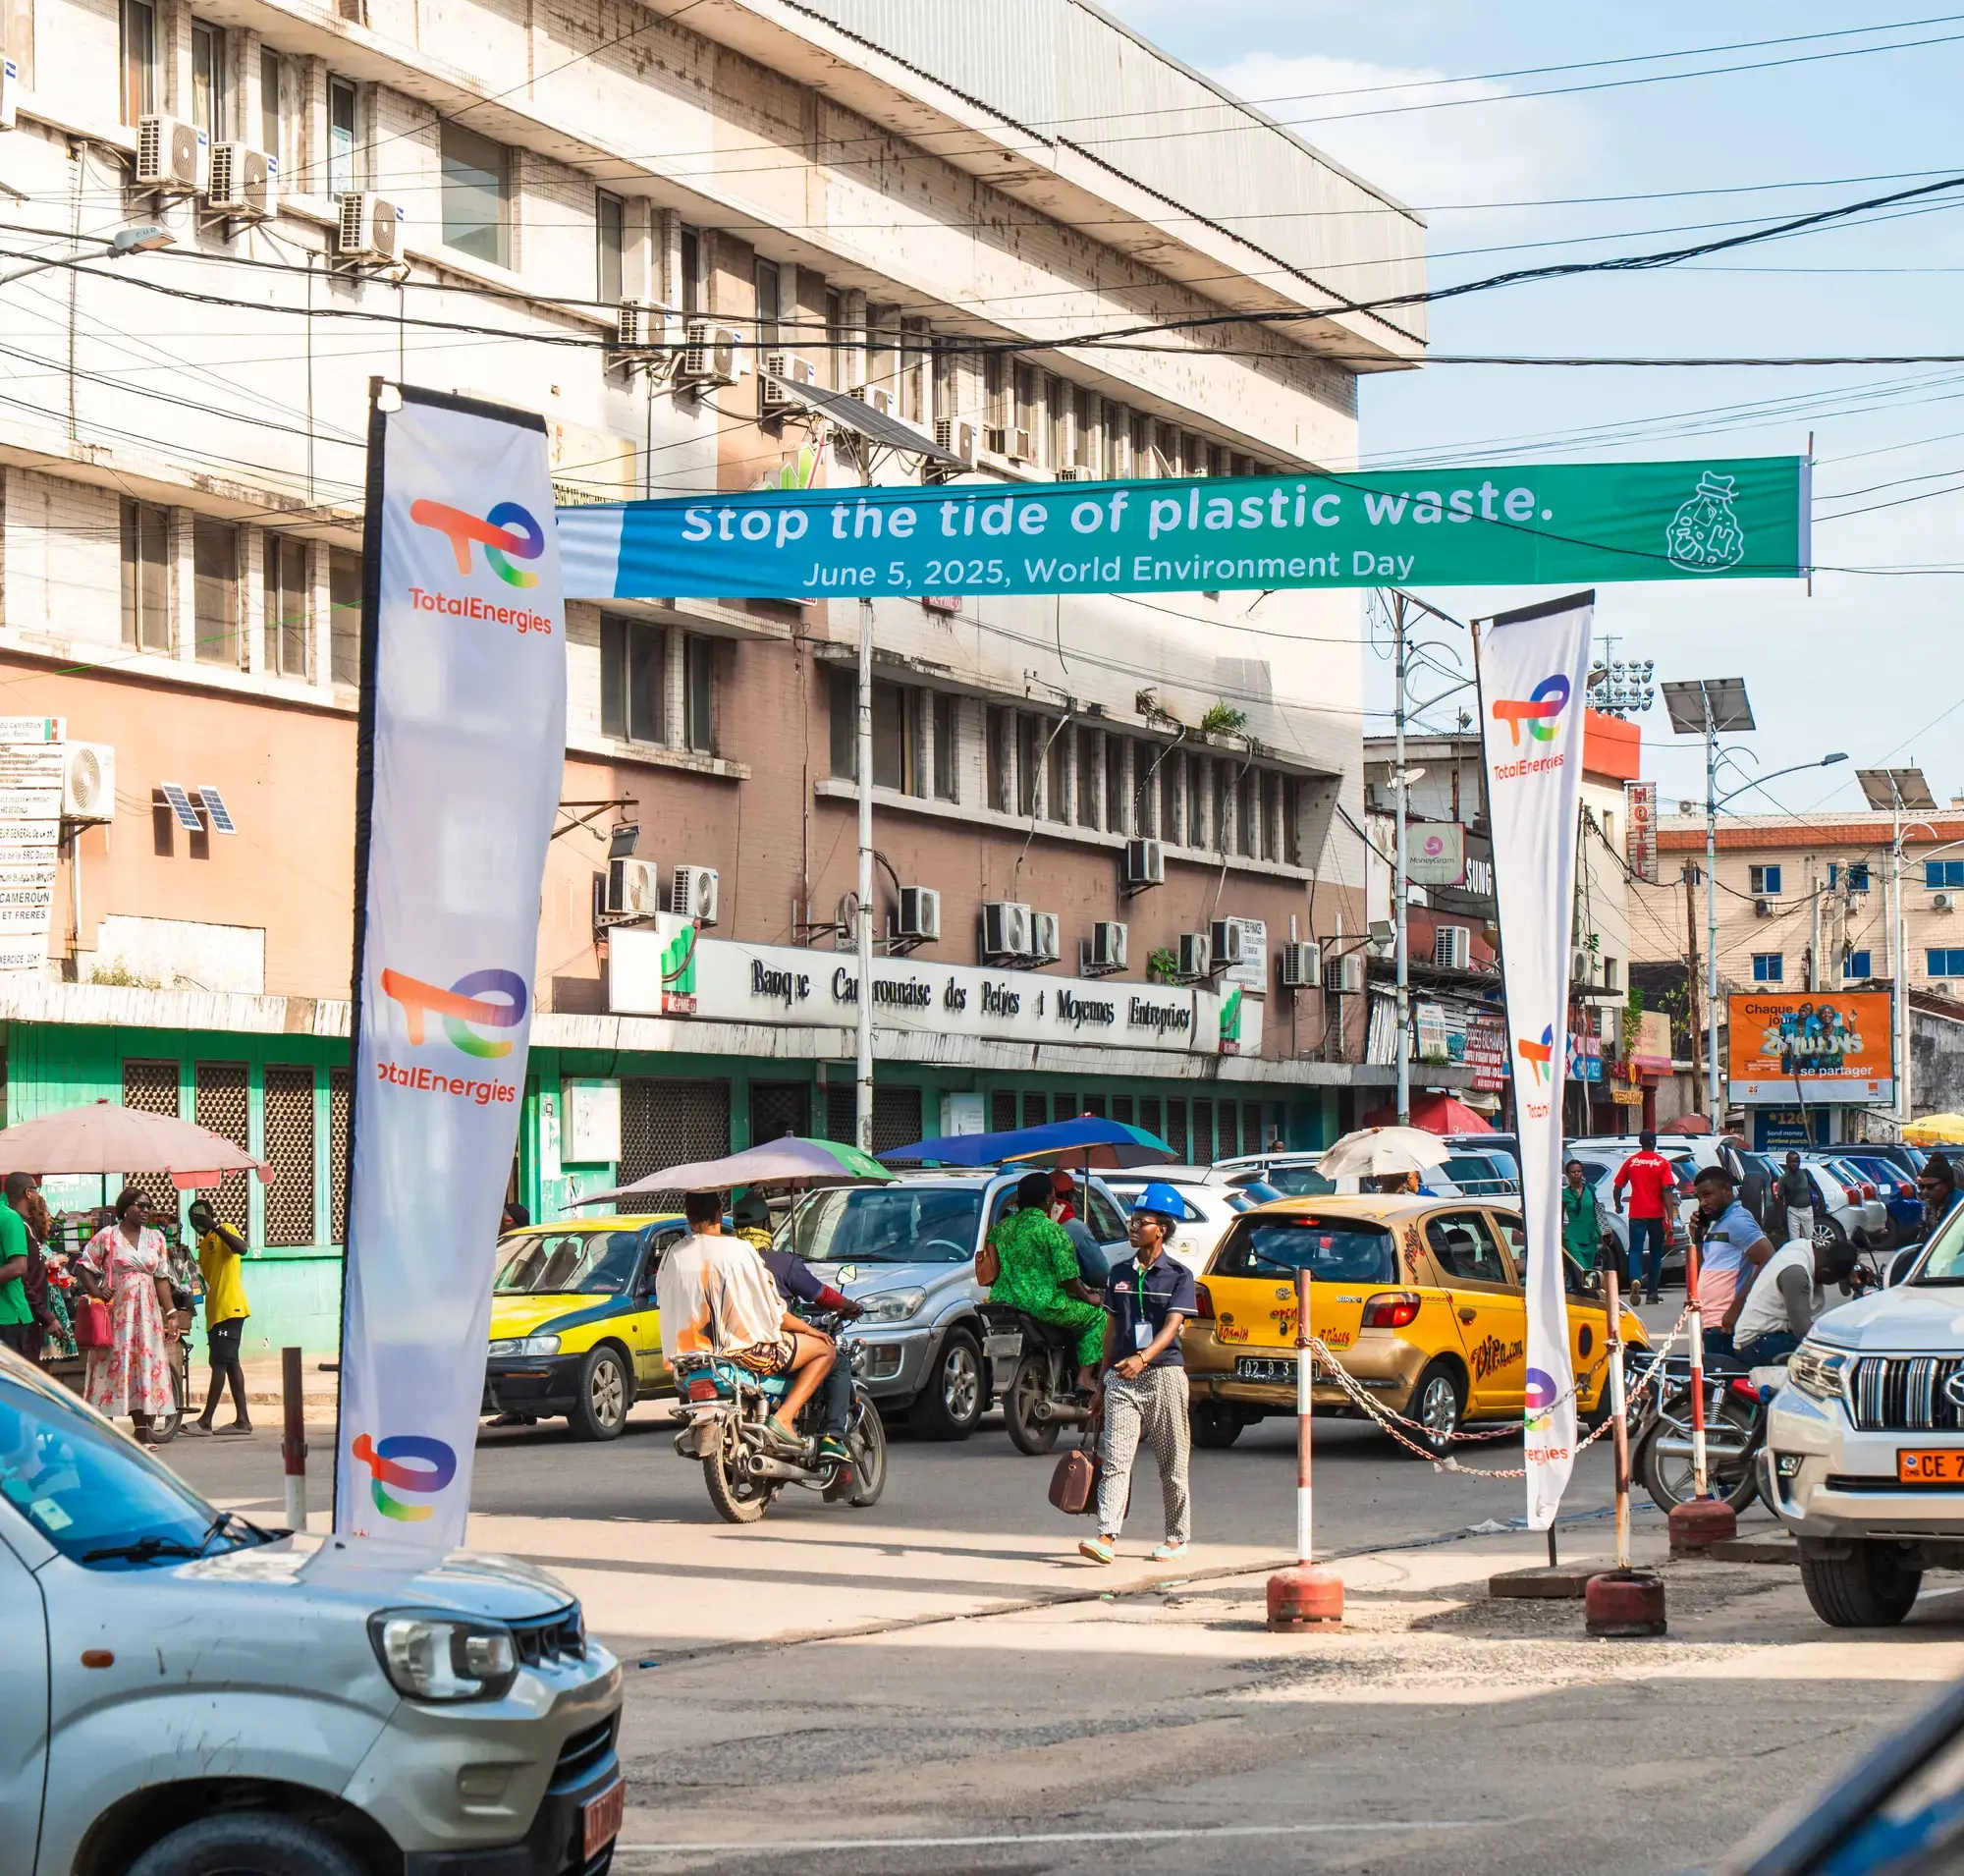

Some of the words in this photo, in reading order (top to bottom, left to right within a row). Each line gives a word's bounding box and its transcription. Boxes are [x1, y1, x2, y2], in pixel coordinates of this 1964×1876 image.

[682, 505, 809, 548] Stop
[831, 498, 917, 538] the
[940, 493, 1048, 537] tide
[1070, 490, 1128, 534] of
[1149, 484, 1341, 540] plastic
[1364, 480, 1553, 525] waste.
[803, 563, 876, 586] June
[887, 561, 912, 589] 5,
[924, 559, 1010, 587] 2025,
[1024, 556, 1121, 582] World
[1133, 553, 1340, 581] Environment
[1352, 550, 1415, 580] Day
[408, 587, 552, 635] TotalEnergies
[1633, 787, 1649, 877] HOTEL
[16, 910, 46, 919] FRERES
[945, 976, 967, 1011] des
[1057, 989, 1116, 1029] Moyennes
[1745, 1004, 1793, 1016] Chaque
[1769, 1015, 1792, 1026] jour
[377, 1061, 516, 1106] otalEnergies
[1800, 1068, 1816, 1076] se
[1819, 1066, 1873, 1077] partager
[1922, 1456, 1946, 1477] CE
